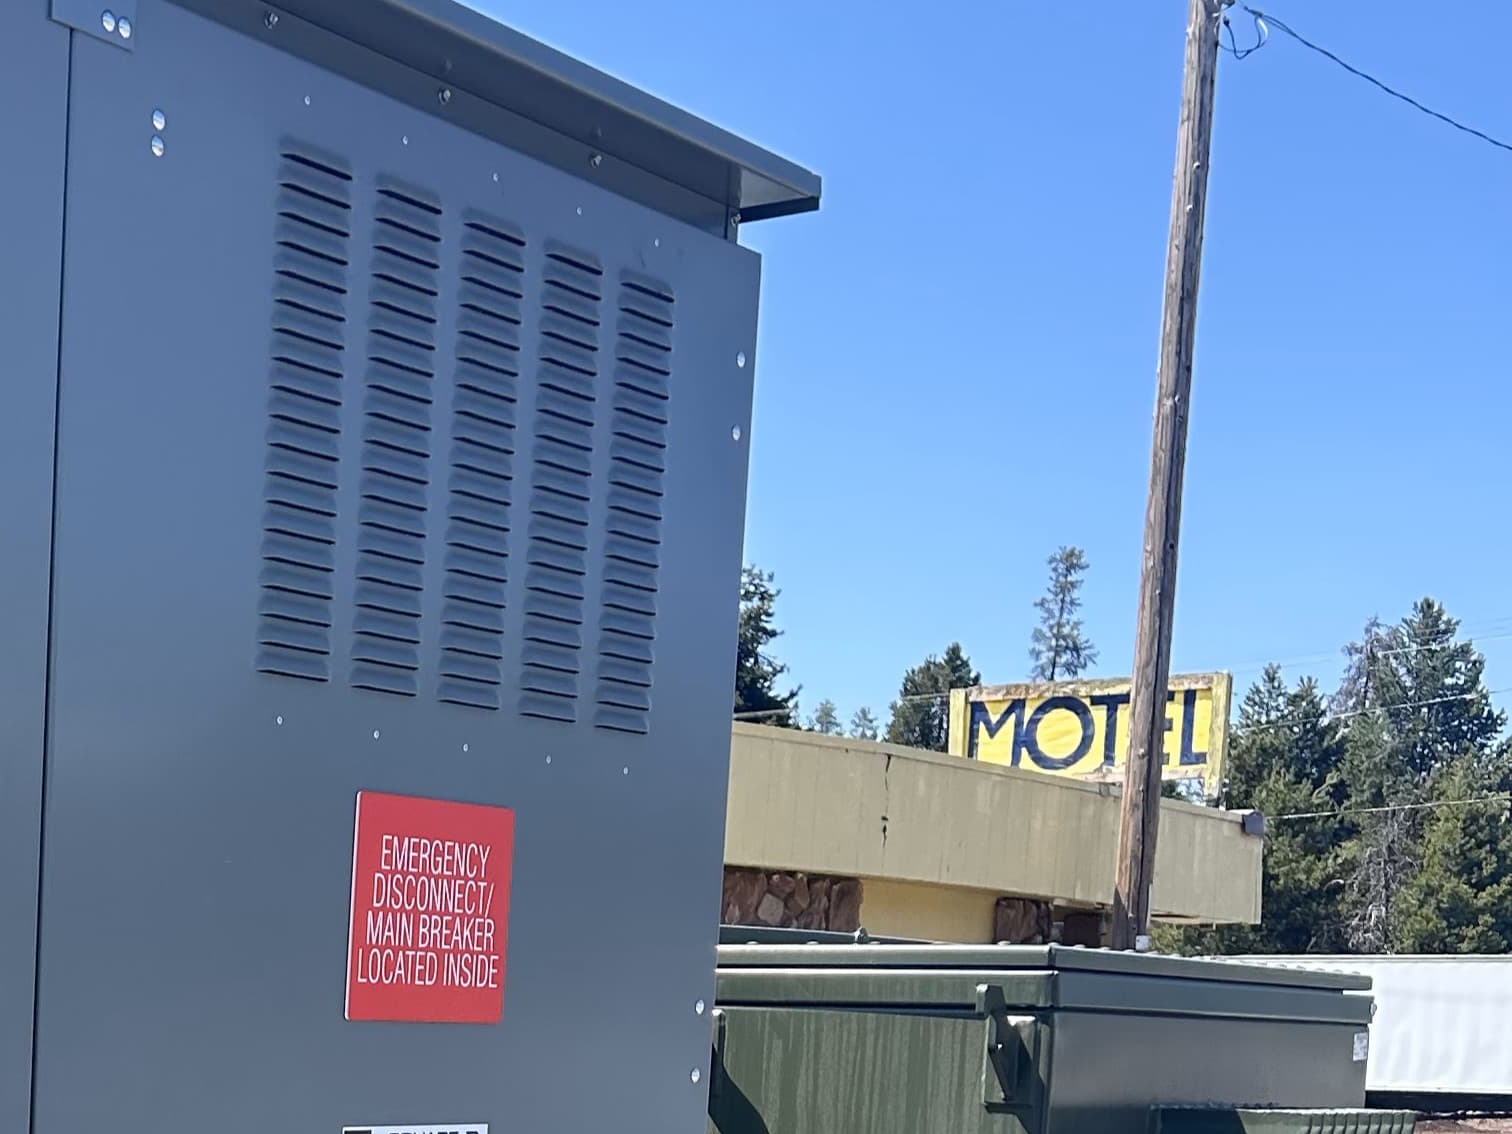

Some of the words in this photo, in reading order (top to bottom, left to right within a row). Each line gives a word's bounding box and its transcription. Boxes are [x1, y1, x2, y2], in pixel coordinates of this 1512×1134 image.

[381, 835, 490, 878] EMERGENCY
[372, 873, 494, 917] DISCONNECT/
[366, 910, 413, 947] MAIN
[418, 914, 495, 952] BREAKER
[357, 948, 437, 985] LOCATED
[443, 953, 499, 988] INSIDE
